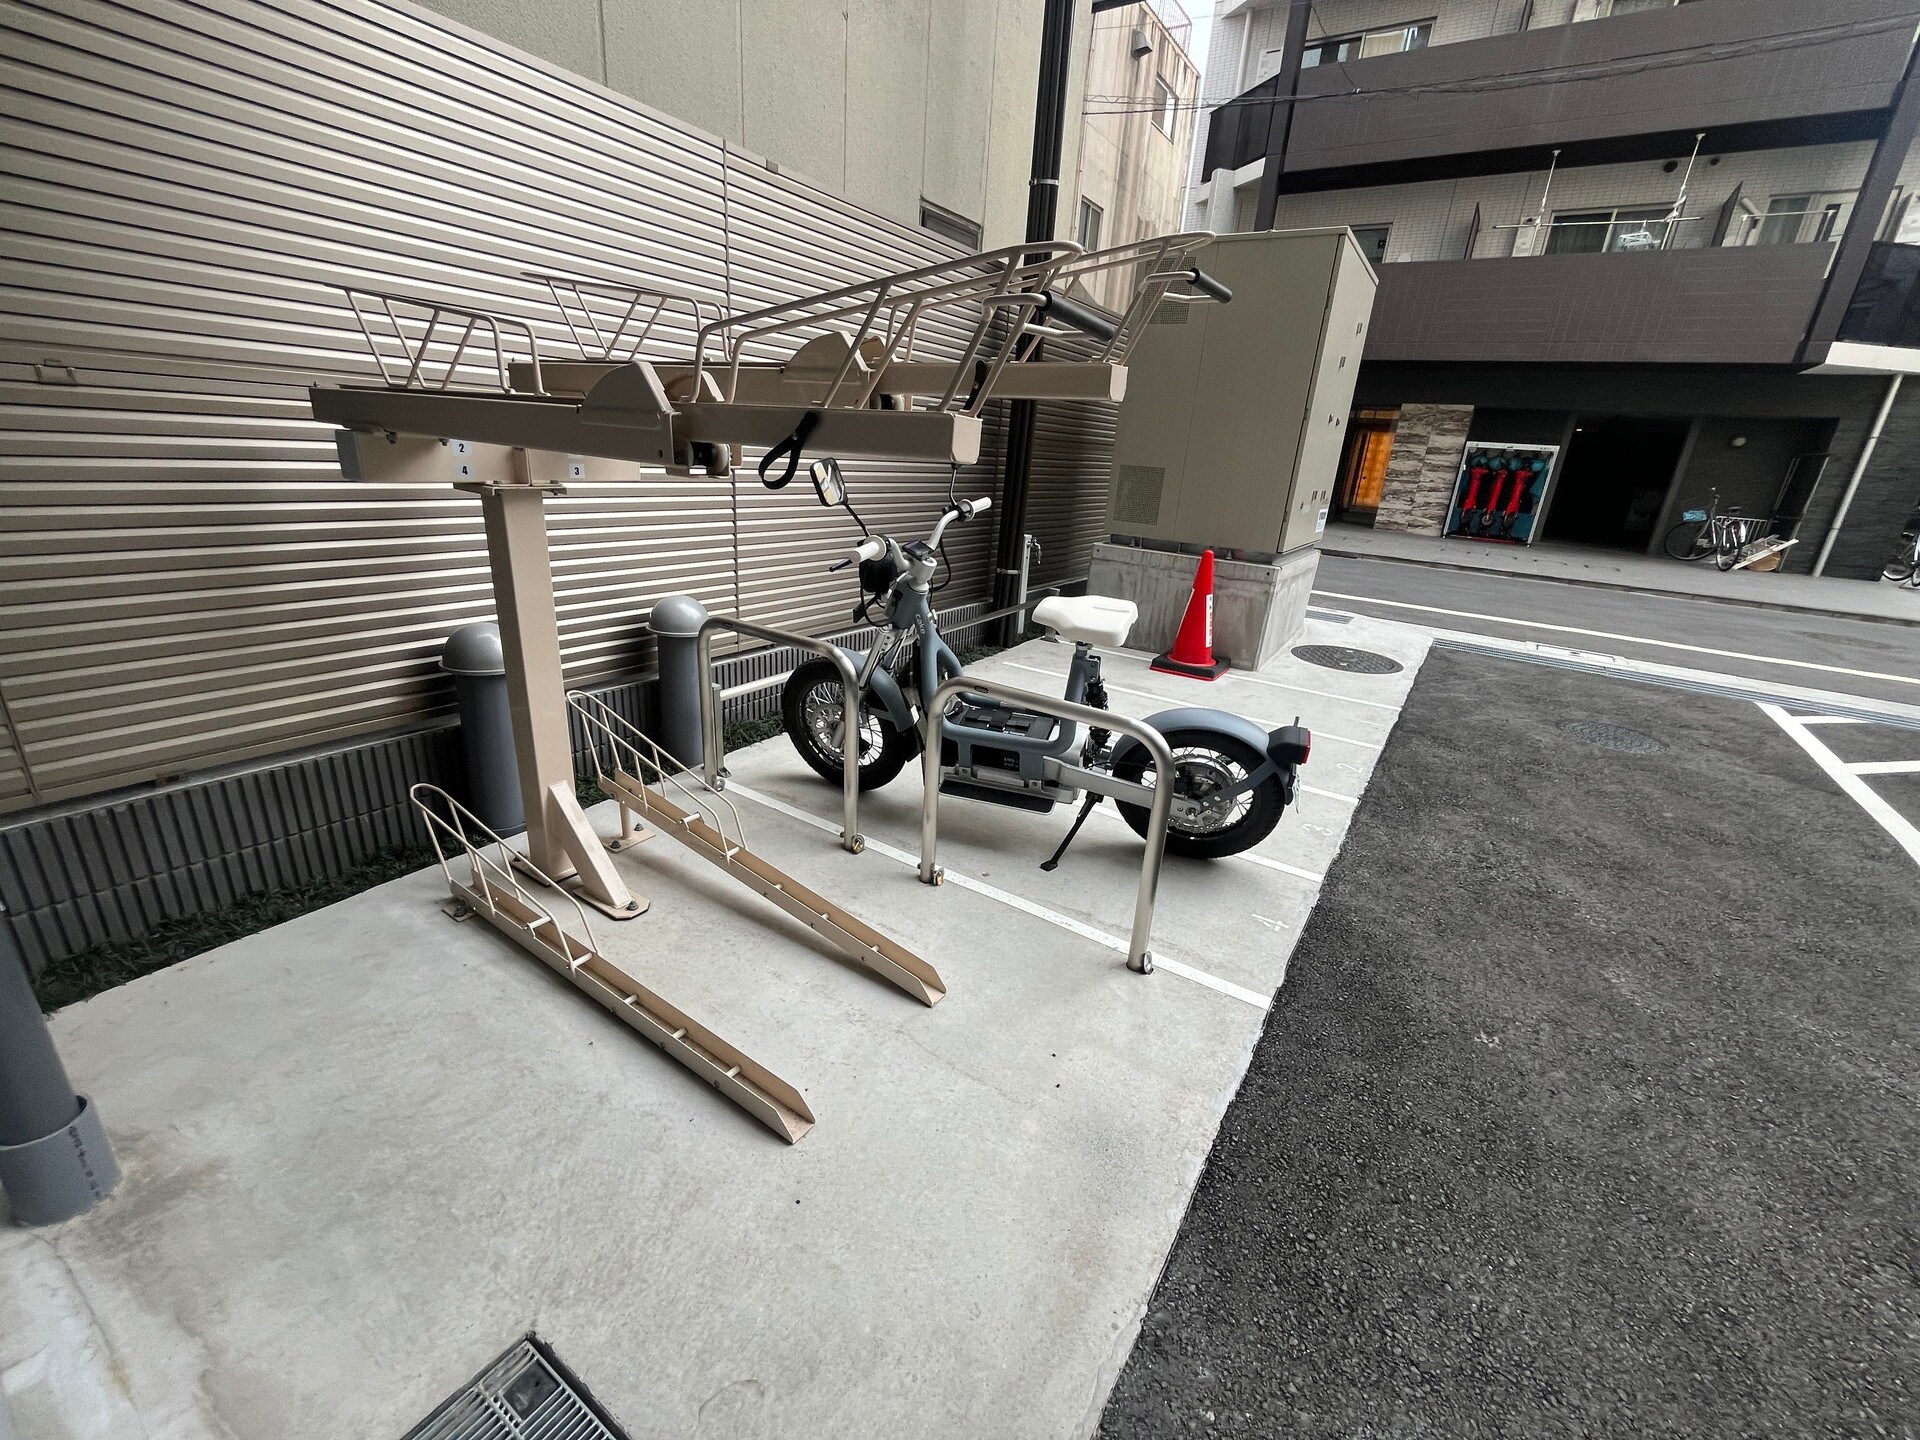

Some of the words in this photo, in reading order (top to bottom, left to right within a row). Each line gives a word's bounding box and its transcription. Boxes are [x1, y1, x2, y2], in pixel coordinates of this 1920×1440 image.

[459, 443, 465, 453] 2
[462, 465, 468, 475] 4
[574, 467, 580, 476] 3
[915, 613, 926, 635] cake
[1336, 763, 1364, 774] 2
[1302, 822, 1334, 837] 3
[1251, 913, 1290, 931] 4
